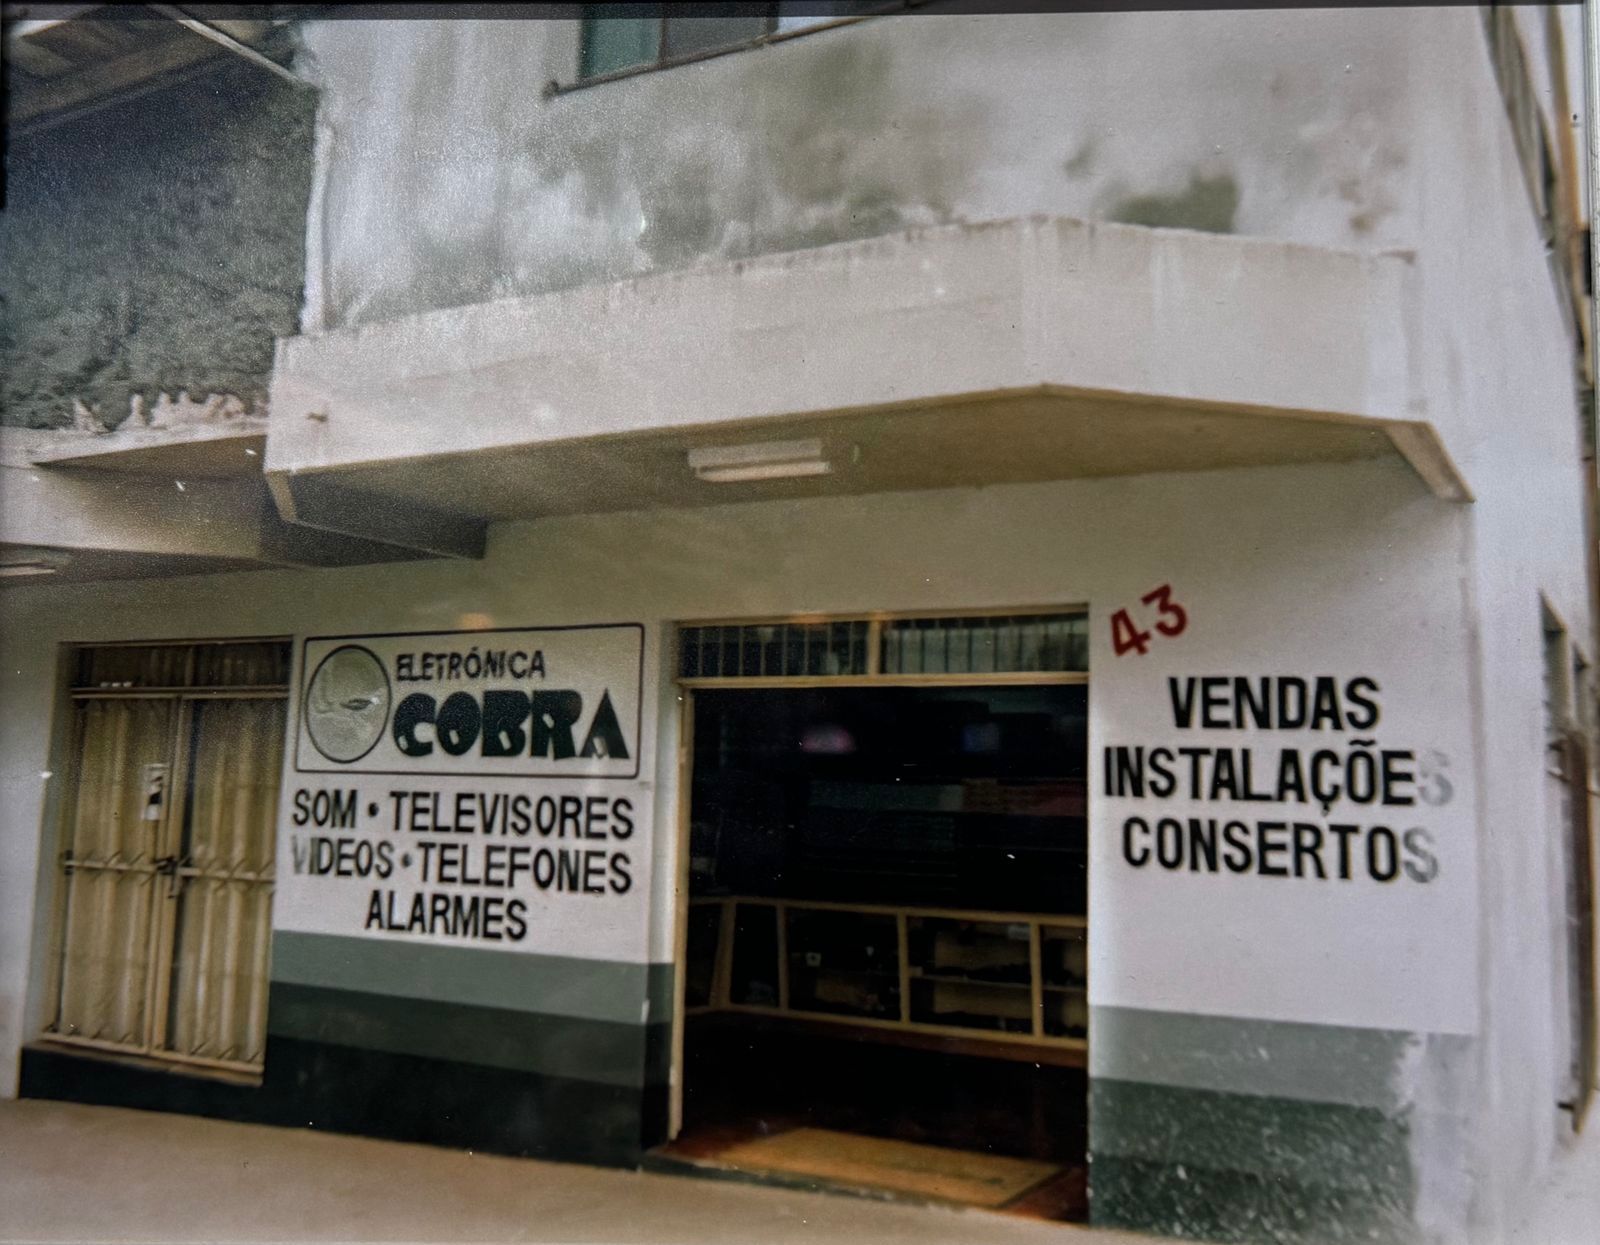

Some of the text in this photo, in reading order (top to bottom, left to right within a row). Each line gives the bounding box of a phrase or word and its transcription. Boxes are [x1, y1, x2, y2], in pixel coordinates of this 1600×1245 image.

[1110, 584, 1187, 657] 43
[392, 688, 630, 761] COBRA
[1168, 676, 1380, 731] VENDAS
[1104, 739, 1453, 816] INSTALAÇÕES
[292, 788, 634, 840] SOM TELEVISORES
[291, 835, 632, 894] VIDEOS TELEFONES
[1123, 816, 1438, 883] CONSERTOS
[365, 889, 528, 940] ALARMES
